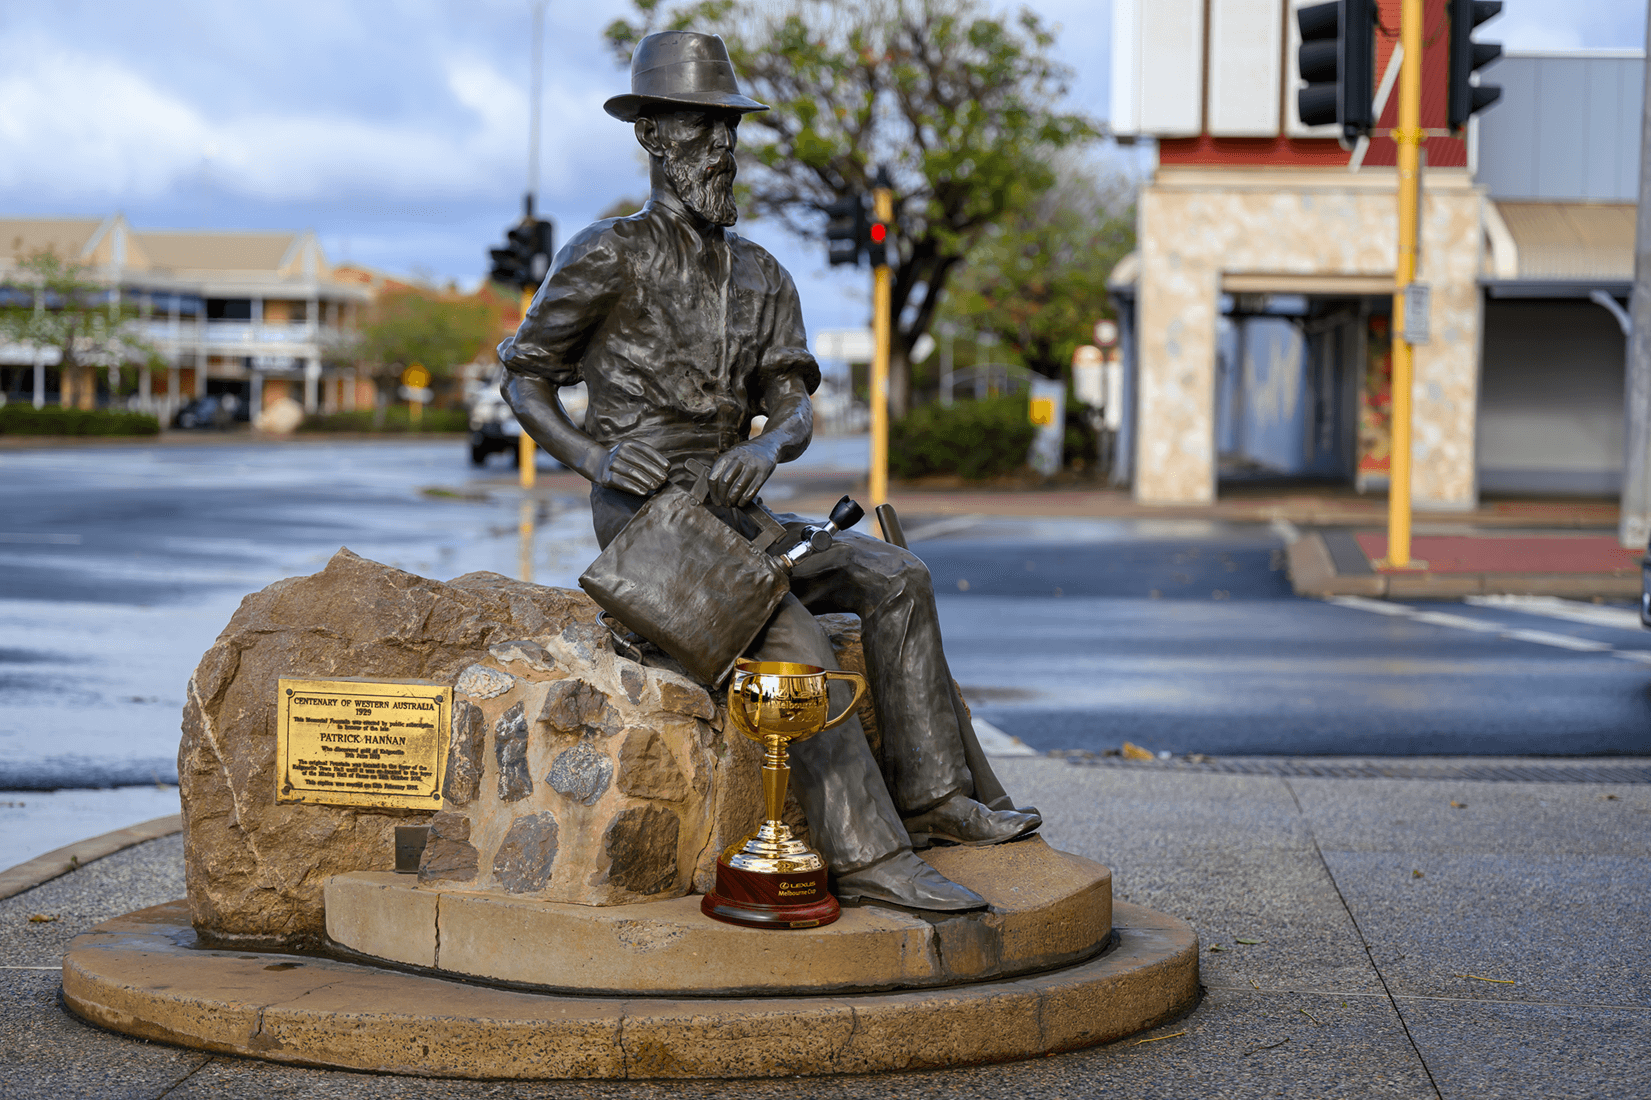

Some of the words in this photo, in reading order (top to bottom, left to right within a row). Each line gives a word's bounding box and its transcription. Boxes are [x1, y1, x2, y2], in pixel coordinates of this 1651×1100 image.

[294, 697, 338, 706] CENTENARY
[354, 700, 389, 708] WESTERN
[393, 702, 434, 710] AUSTRALIA
[320, 733, 360, 743] PATRICK
[365, 735, 406, 745] HANNAN
